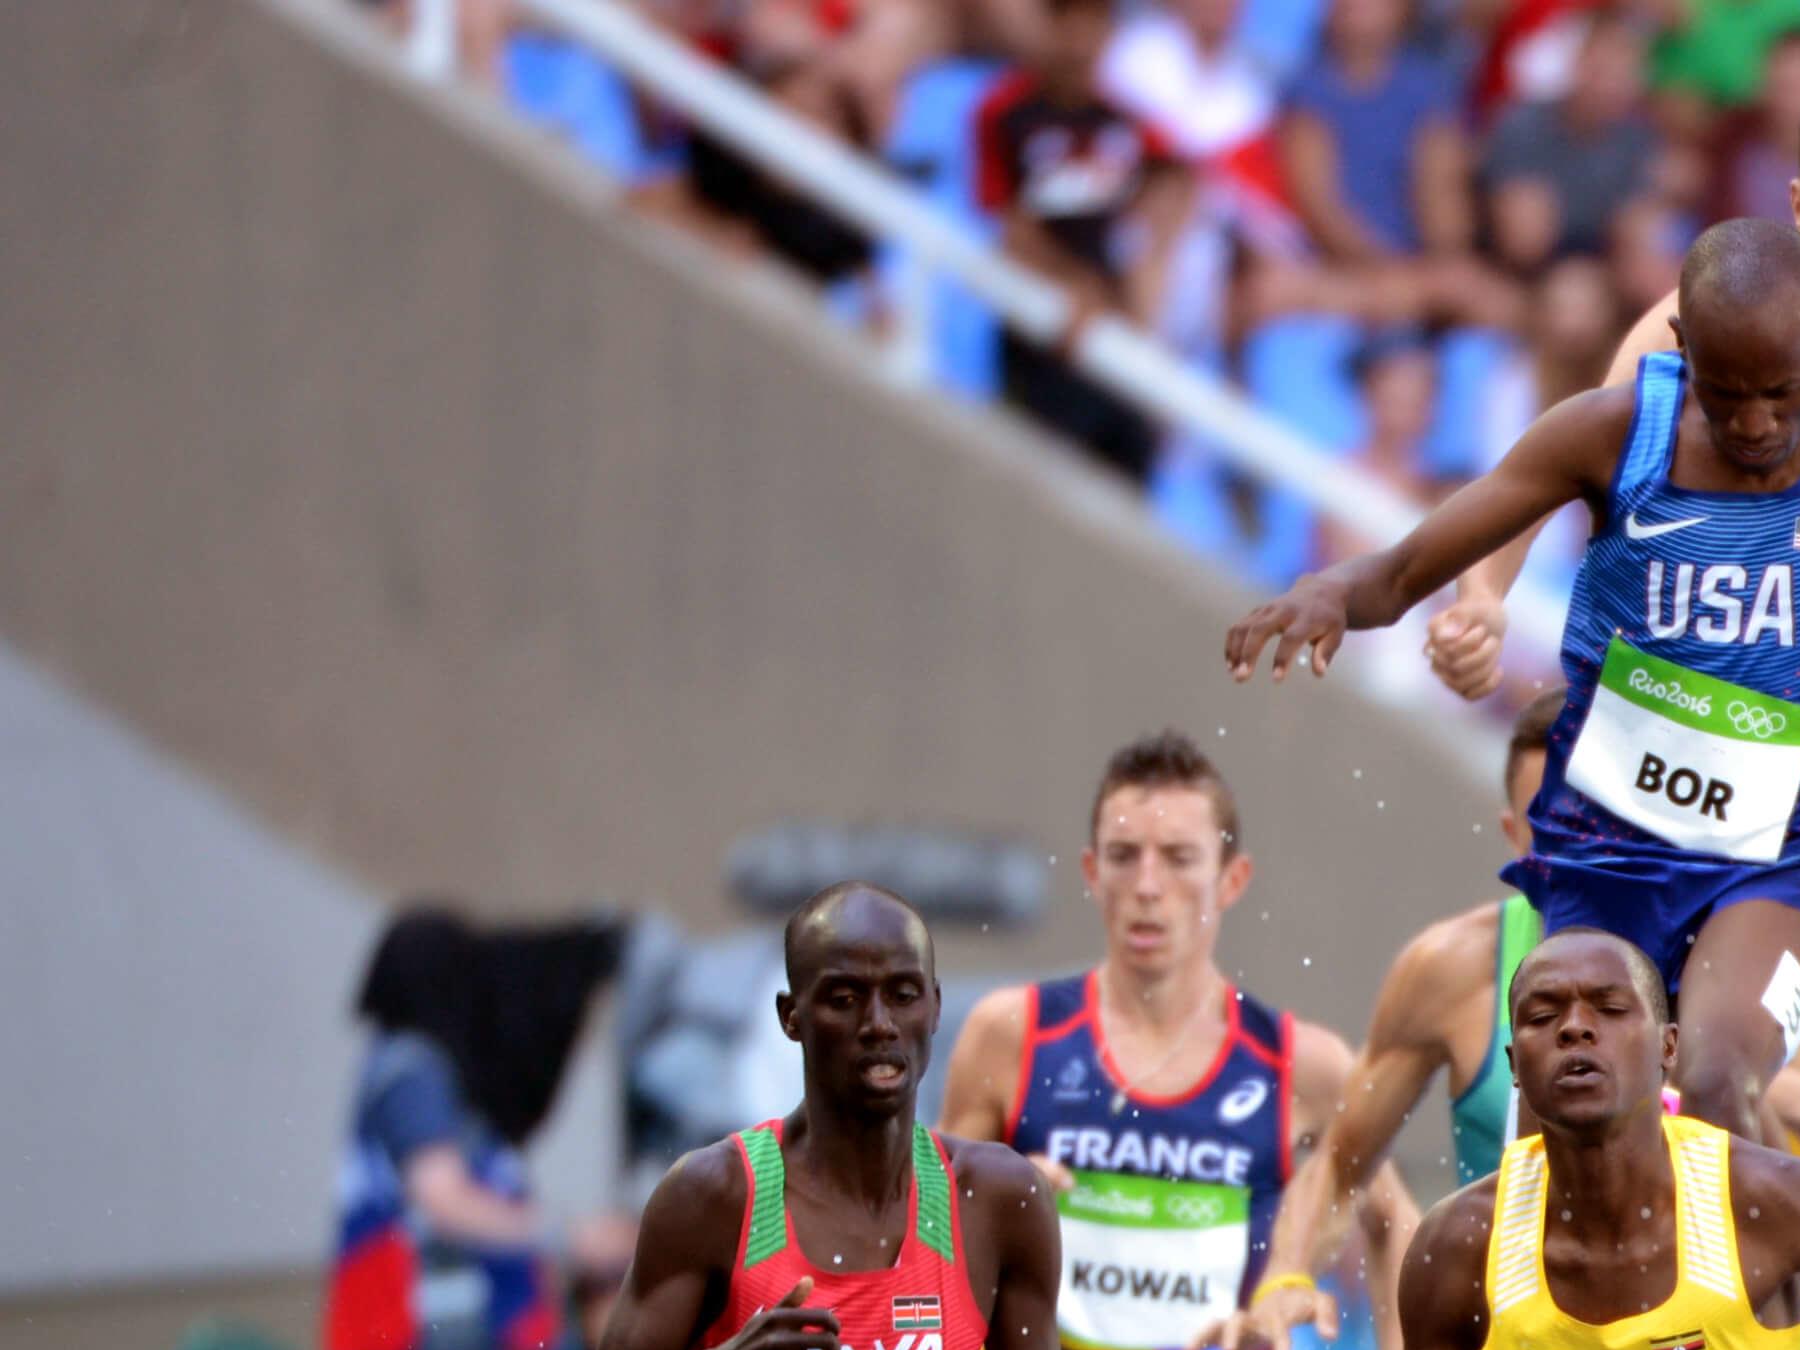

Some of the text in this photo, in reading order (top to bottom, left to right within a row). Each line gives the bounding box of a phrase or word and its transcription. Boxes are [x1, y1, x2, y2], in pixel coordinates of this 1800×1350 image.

[1646, 561, 1796, 648] USA
[1627, 667, 1713, 719] Rio2016
[1634, 751, 1735, 822] BOR
[1045, 1127, 1254, 1186] FRANCE
[1071, 1260, 1213, 1306] KOWAL
